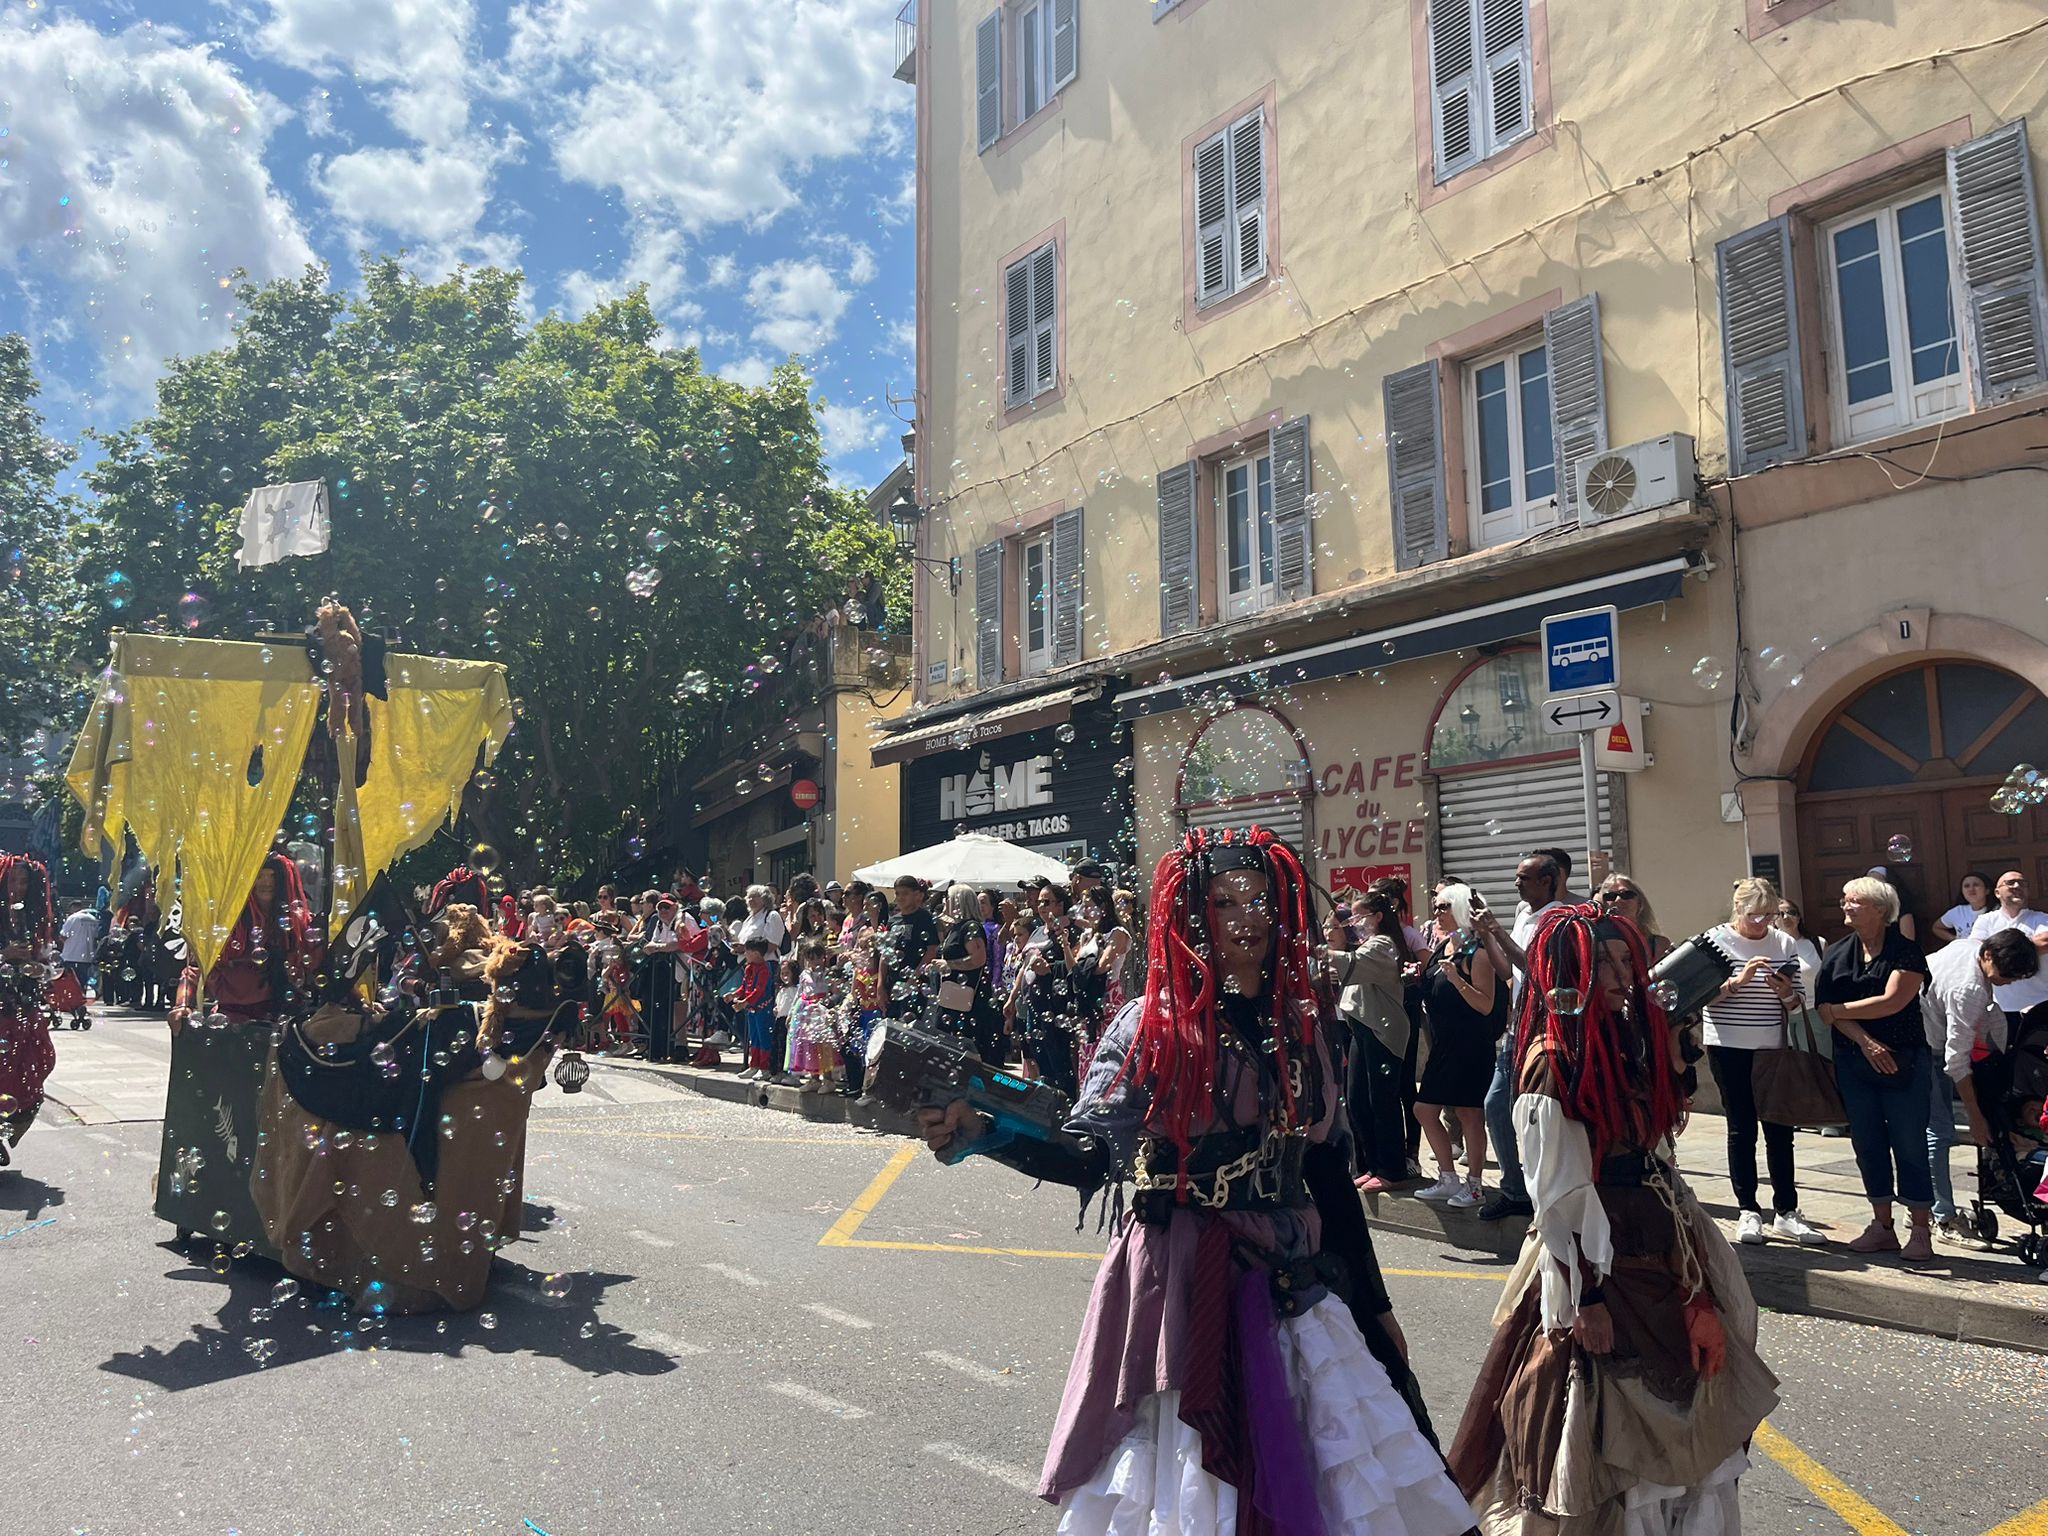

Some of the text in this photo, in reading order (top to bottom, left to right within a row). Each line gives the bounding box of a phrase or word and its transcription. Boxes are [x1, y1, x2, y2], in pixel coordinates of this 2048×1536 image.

[925, 735, 947, 750] HOME
[972, 729, 979, 739] &
[980, 724, 1002, 737] Tacos
[1322, 753, 1416, 797] CAFE
[1356, 799, 1381, 819] du
[1015, 821, 1028, 840] &
[1028, 814, 1071, 838] TACOS
[1321, 819, 1425, 860] LYCEE
